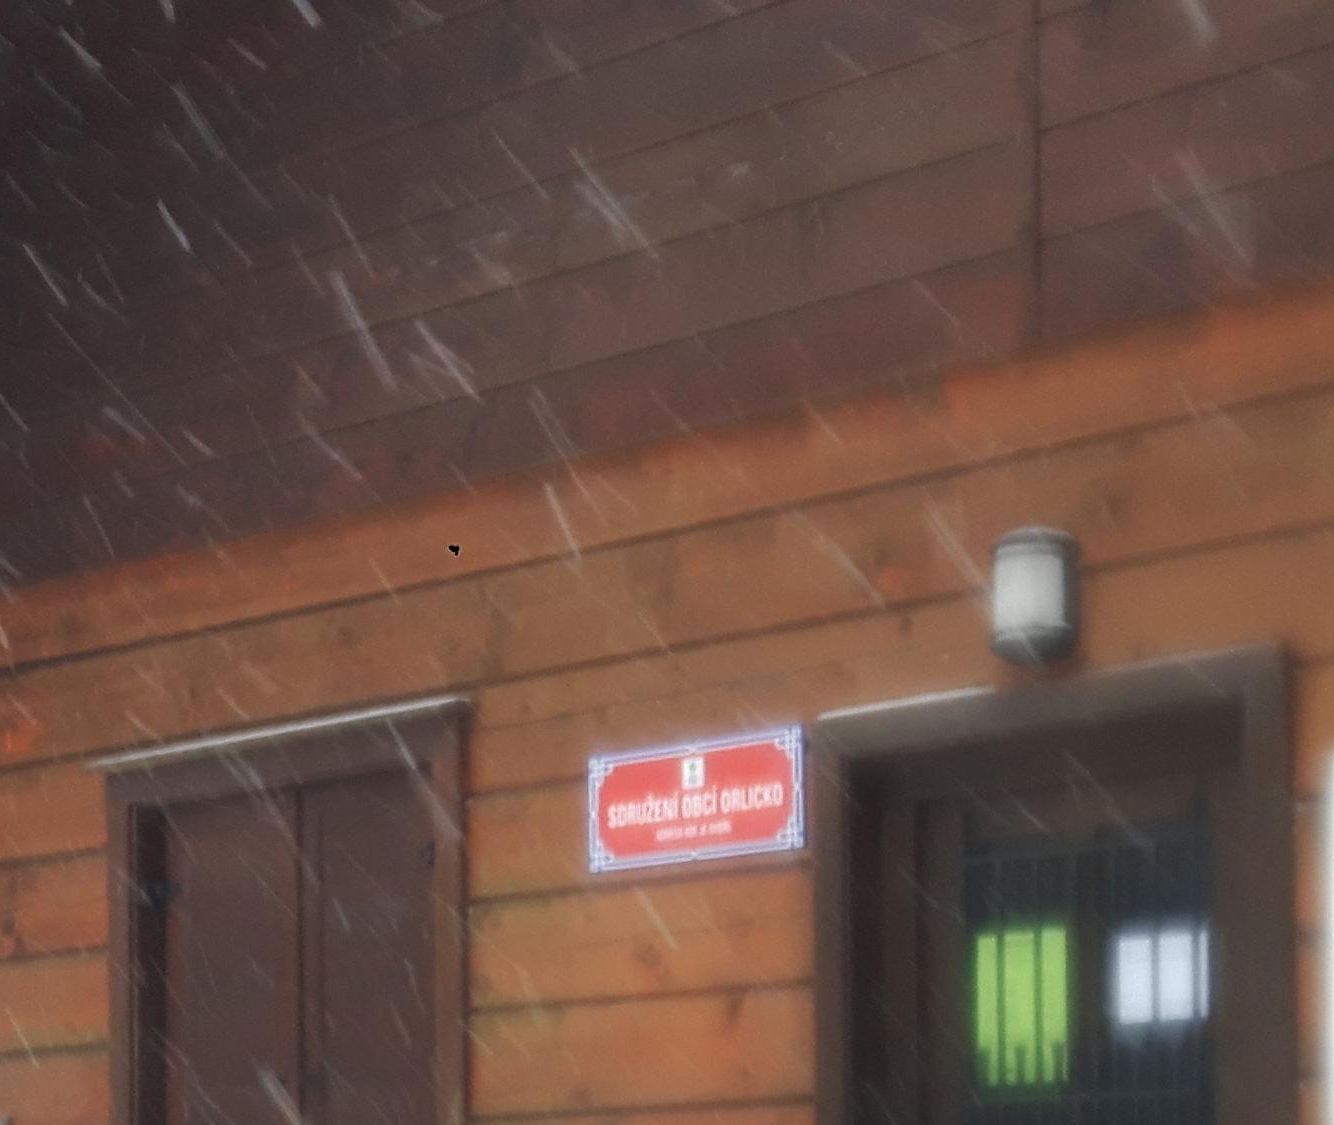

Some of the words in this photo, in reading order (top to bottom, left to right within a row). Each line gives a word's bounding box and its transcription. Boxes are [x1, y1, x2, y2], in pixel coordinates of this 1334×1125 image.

[607, 791, 679, 829] SDRUŽENÍ
[681, 786, 717, 819] OBCÍ
[720, 782, 784, 814] ORLICKO
